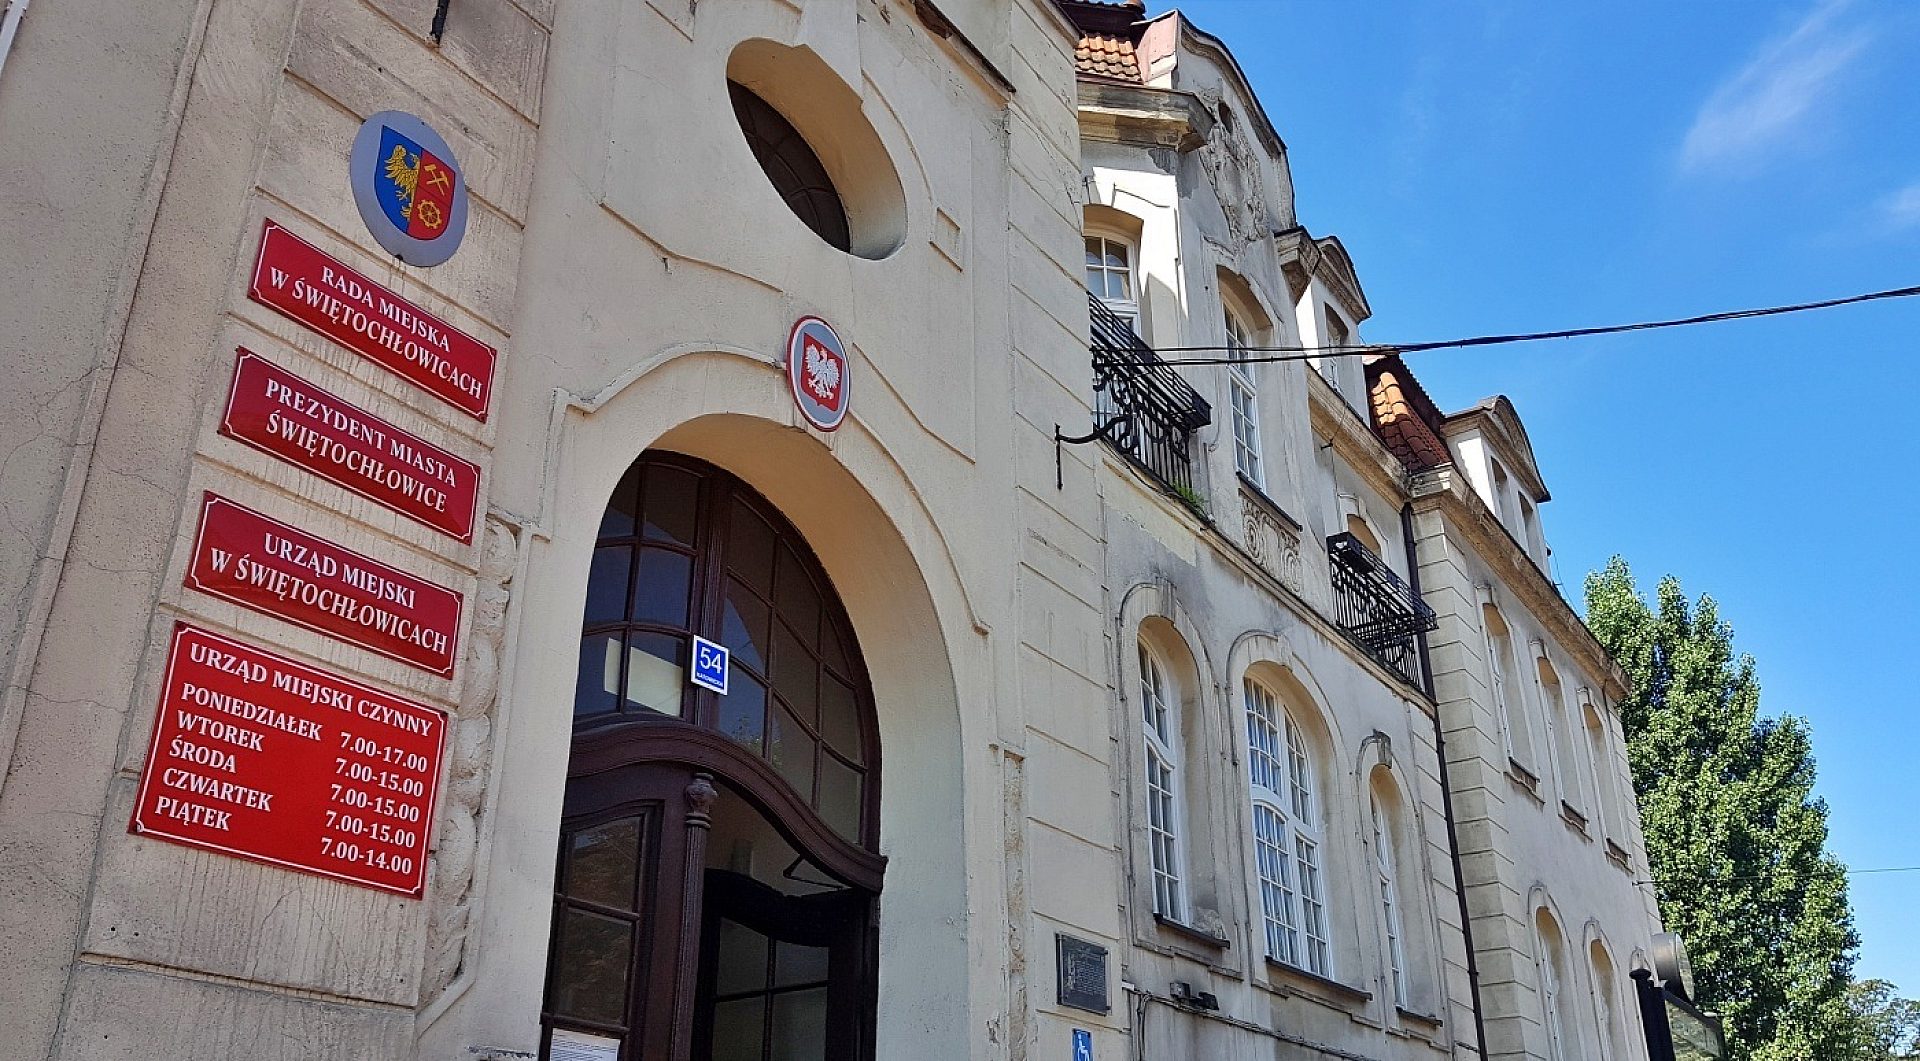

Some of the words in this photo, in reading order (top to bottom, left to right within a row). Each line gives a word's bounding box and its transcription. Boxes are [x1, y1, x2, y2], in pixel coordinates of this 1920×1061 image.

[321, 266, 374, 309] RADA
[379, 297, 450, 353] MIEJSKA
[269, 266, 289, 291] W
[291, 277, 483, 400] ŚWIĘTOCHŁOWICACH
[265, 379, 386, 451] PREZYDENT
[390, 438, 456, 488] MIASTA
[266, 410, 447, 513] ŚWIĘTOCHŁOWICE
[265, 533, 337, 579] URZĄD
[341, 563, 416, 610] MIEJSKI
[210, 548, 233, 573] W
[235, 554, 448, 655] ŚWIĘTOCHŁOWICACH
[700, 646, 722, 674] 54
[190, 642, 267, 684] URZĄD
[272, 671, 354, 712] MIEJSKI
[357, 699, 433, 737] CZYNNY
[177, 710, 264, 752] WTOREK
[181, 683, 323, 741] PONIEDZIAŁEK
[169, 734, 236, 774] ŚRODA
[340, 731, 428, 773] 7.00-17.00
[162, 768, 273, 812] CZWARTEK
[335, 757, 424, 797] 7.00-15.00
[154, 796, 232, 831] PIĄTEK
[331, 783, 419, 822] 7.00-15.00
[326, 809, 416, 848] 7.00-15.00
[321, 836, 412, 875] 7.00-14.00
